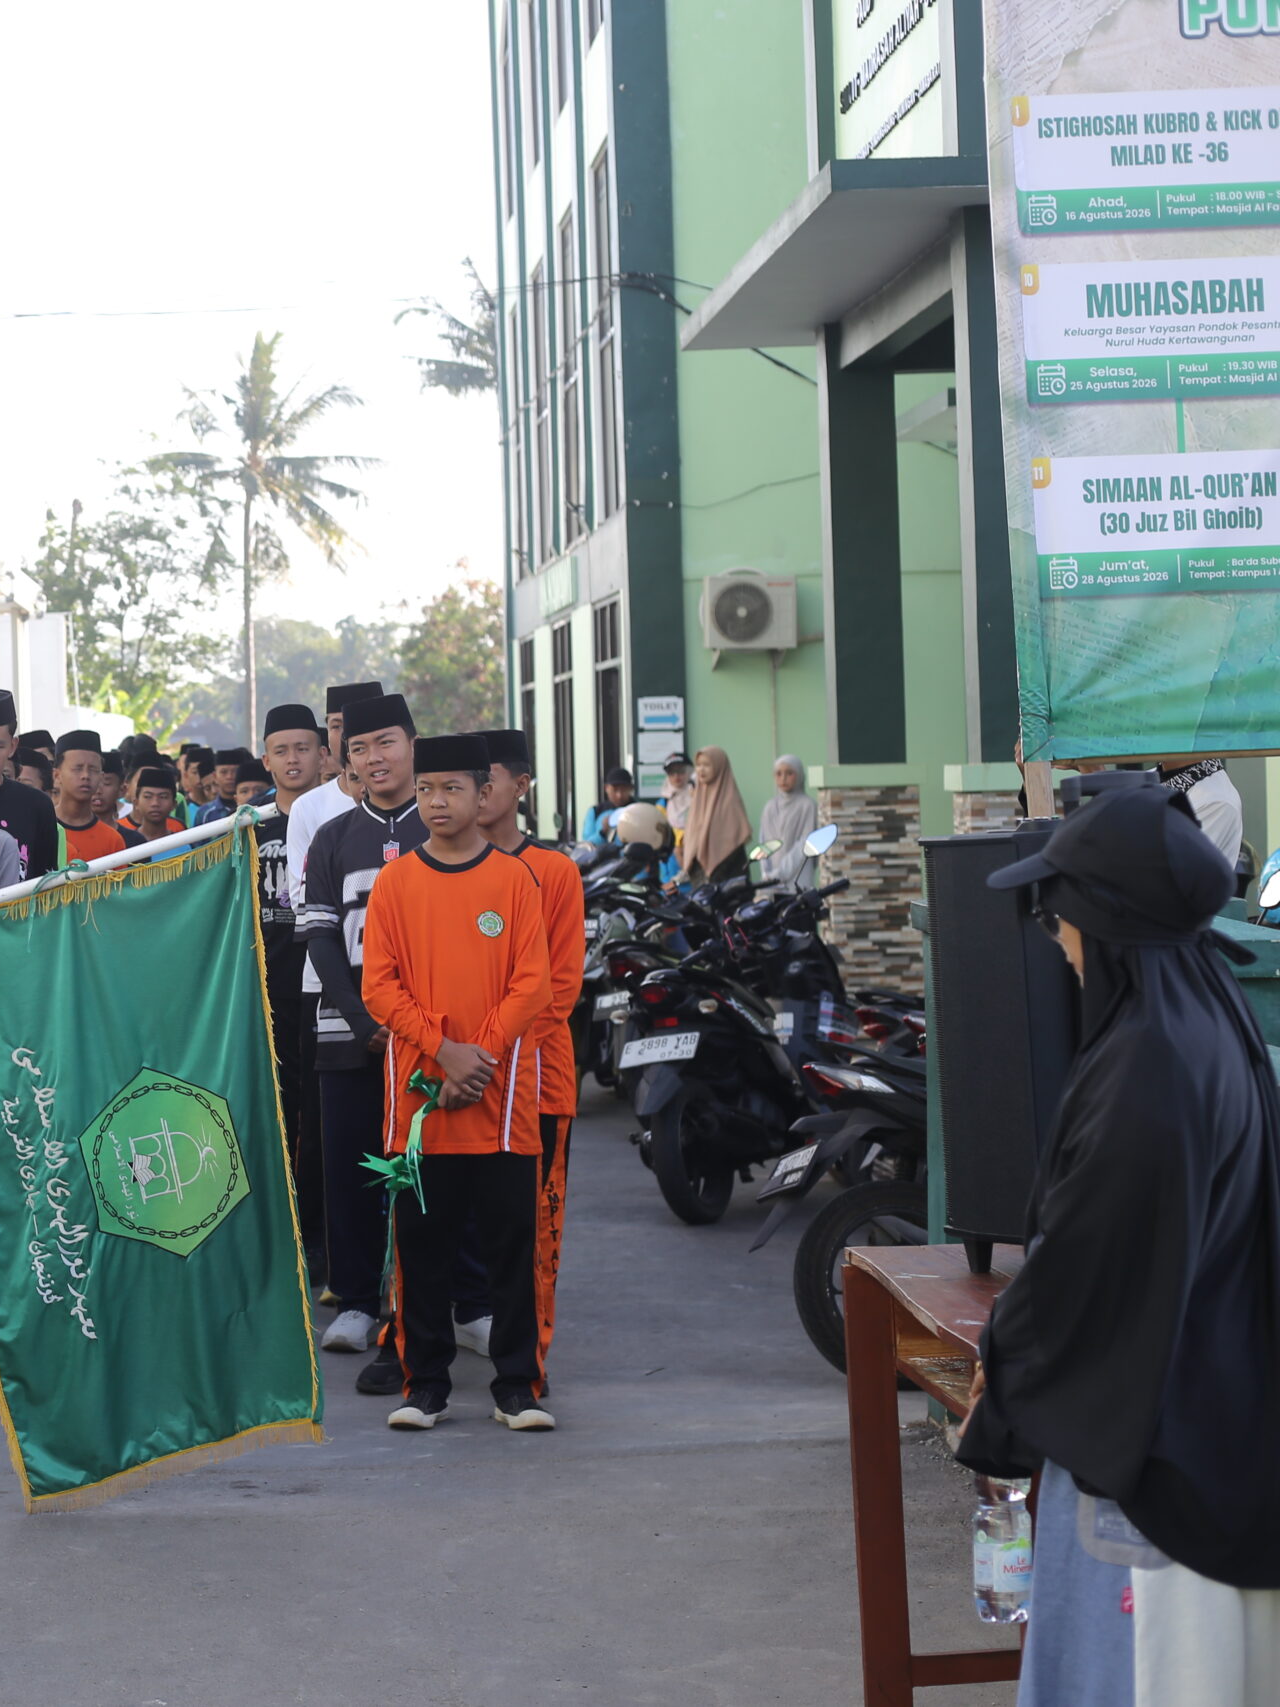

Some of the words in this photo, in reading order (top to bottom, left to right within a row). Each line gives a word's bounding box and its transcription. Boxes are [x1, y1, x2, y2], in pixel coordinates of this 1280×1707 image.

[1037, 113, 1138, 139] ISTIGHOSAH
[1144, 111, 1200, 135] KUBRO
[1206, 111, 1218, 132] &
[1223, 108, 1263, 131] KICK
[1110, 144, 1166, 167] MILAD
[1172, 143, 1193, 164] KE
[1198, 141, 1229, 163] -36
[1088, 196, 1128, 209] Ahad,
[1166, 193, 1196, 203] Pukul
[1216, 190, 1242, 201] 18.00
[1245, 190, 1266, 200] WIB
[1065, 211, 1076, 221] 16
[1078, 209, 1123, 223] Agustus
[1125, 208, 1151, 219] 2026
[1166, 205, 1209, 217] Tempat
[1216, 203, 1252, 216] Masjid
[1255, 202, 1265, 212] Al
[1023, 272, 1033, 287] 10
[1086, 277, 1265, 318] MUHASABAH
[1064, 326, 1113, 339] Keluarga
[1115, 325, 1146, 336] Besar
[1149, 322, 1196, 337] Yayasan
[1198, 321, 1239, 332] Pondok
[1105, 337, 1135, 349] Nurul
[1137, 335, 1166, 347] Huda
[1168, 333, 1255, 347] Kertawangunan
[1089, 365, 1138, 379] Selasa,
[1178, 362, 1208, 373] Pukul
[1228, 361, 1255, 371] 19.30
[1257, 360, 1278, 369] WIB
[1070, 380, 1083, 391] 25
[1085, 379, 1130, 393] Agustus
[1132, 378, 1158, 389] 2026
[1179, 375, 1222, 388] Tempat
[1229, 373, 1264, 385] Masjid
[1267, 372, 1278, 382] Al
[1032, 466, 1044, 481] 11
[1082, 476, 1162, 504] SIMAAN
[1169, 471, 1278, 501] AL-QUR'AN
[1099, 512, 1130, 536] (30
[1135, 511, 1168, 533] Juz
[1173, 508, 1197, 532] Bil
[1203, 506, 1263, 530] Ghoib)
[1188, 558, 1215, 568] Pukul
[1231, 557, 1259, 567] Ba'da
[1081, 574, 1095, 585] 28
[1097, 572, 1141, 587] Agustus
[1142, 571, 1169, 583] 2026
[1188, 569, 1226, 581] Tempat
[1231, 568, 1271, 579] Kampus
[624, 1044, 632, 1056] E
[56, 1240, 91, 1279] نور
[1017, 1555, 1027, 1566] Le
